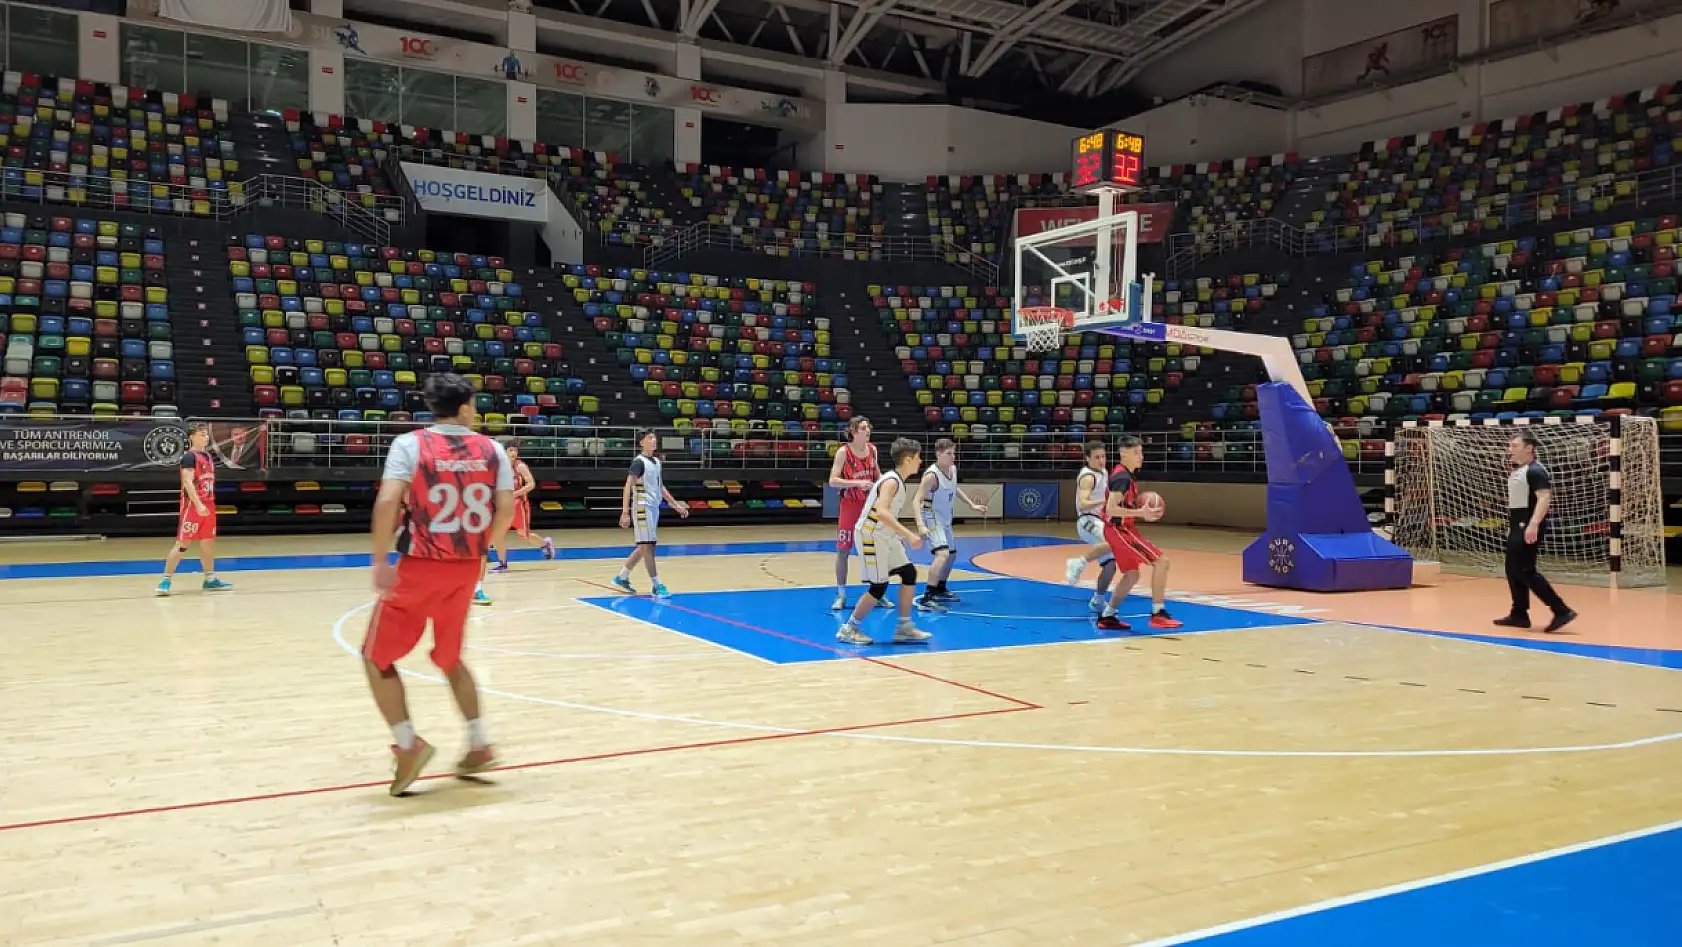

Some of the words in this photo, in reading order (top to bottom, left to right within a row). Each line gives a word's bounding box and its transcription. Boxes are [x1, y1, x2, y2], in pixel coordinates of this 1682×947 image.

[1116, 134, 1142, 153] 6:48
[1112, 153, 1139, 184] 32
[413, 180, 536, 207] HOŞGELDİNİZ
[13, 429, 41, 440] TÜM
[44, 429, 109, 440] ANTRENÖR
[17, 440, 123, 451] SPORCULARIMIZA
[3, 452, 60, 461] BAŞARILAR
[62, 452, 119, 461] DİLİYORUM
[428, 483, 492, 533] 28
[183, 521, 199, 534] 30
